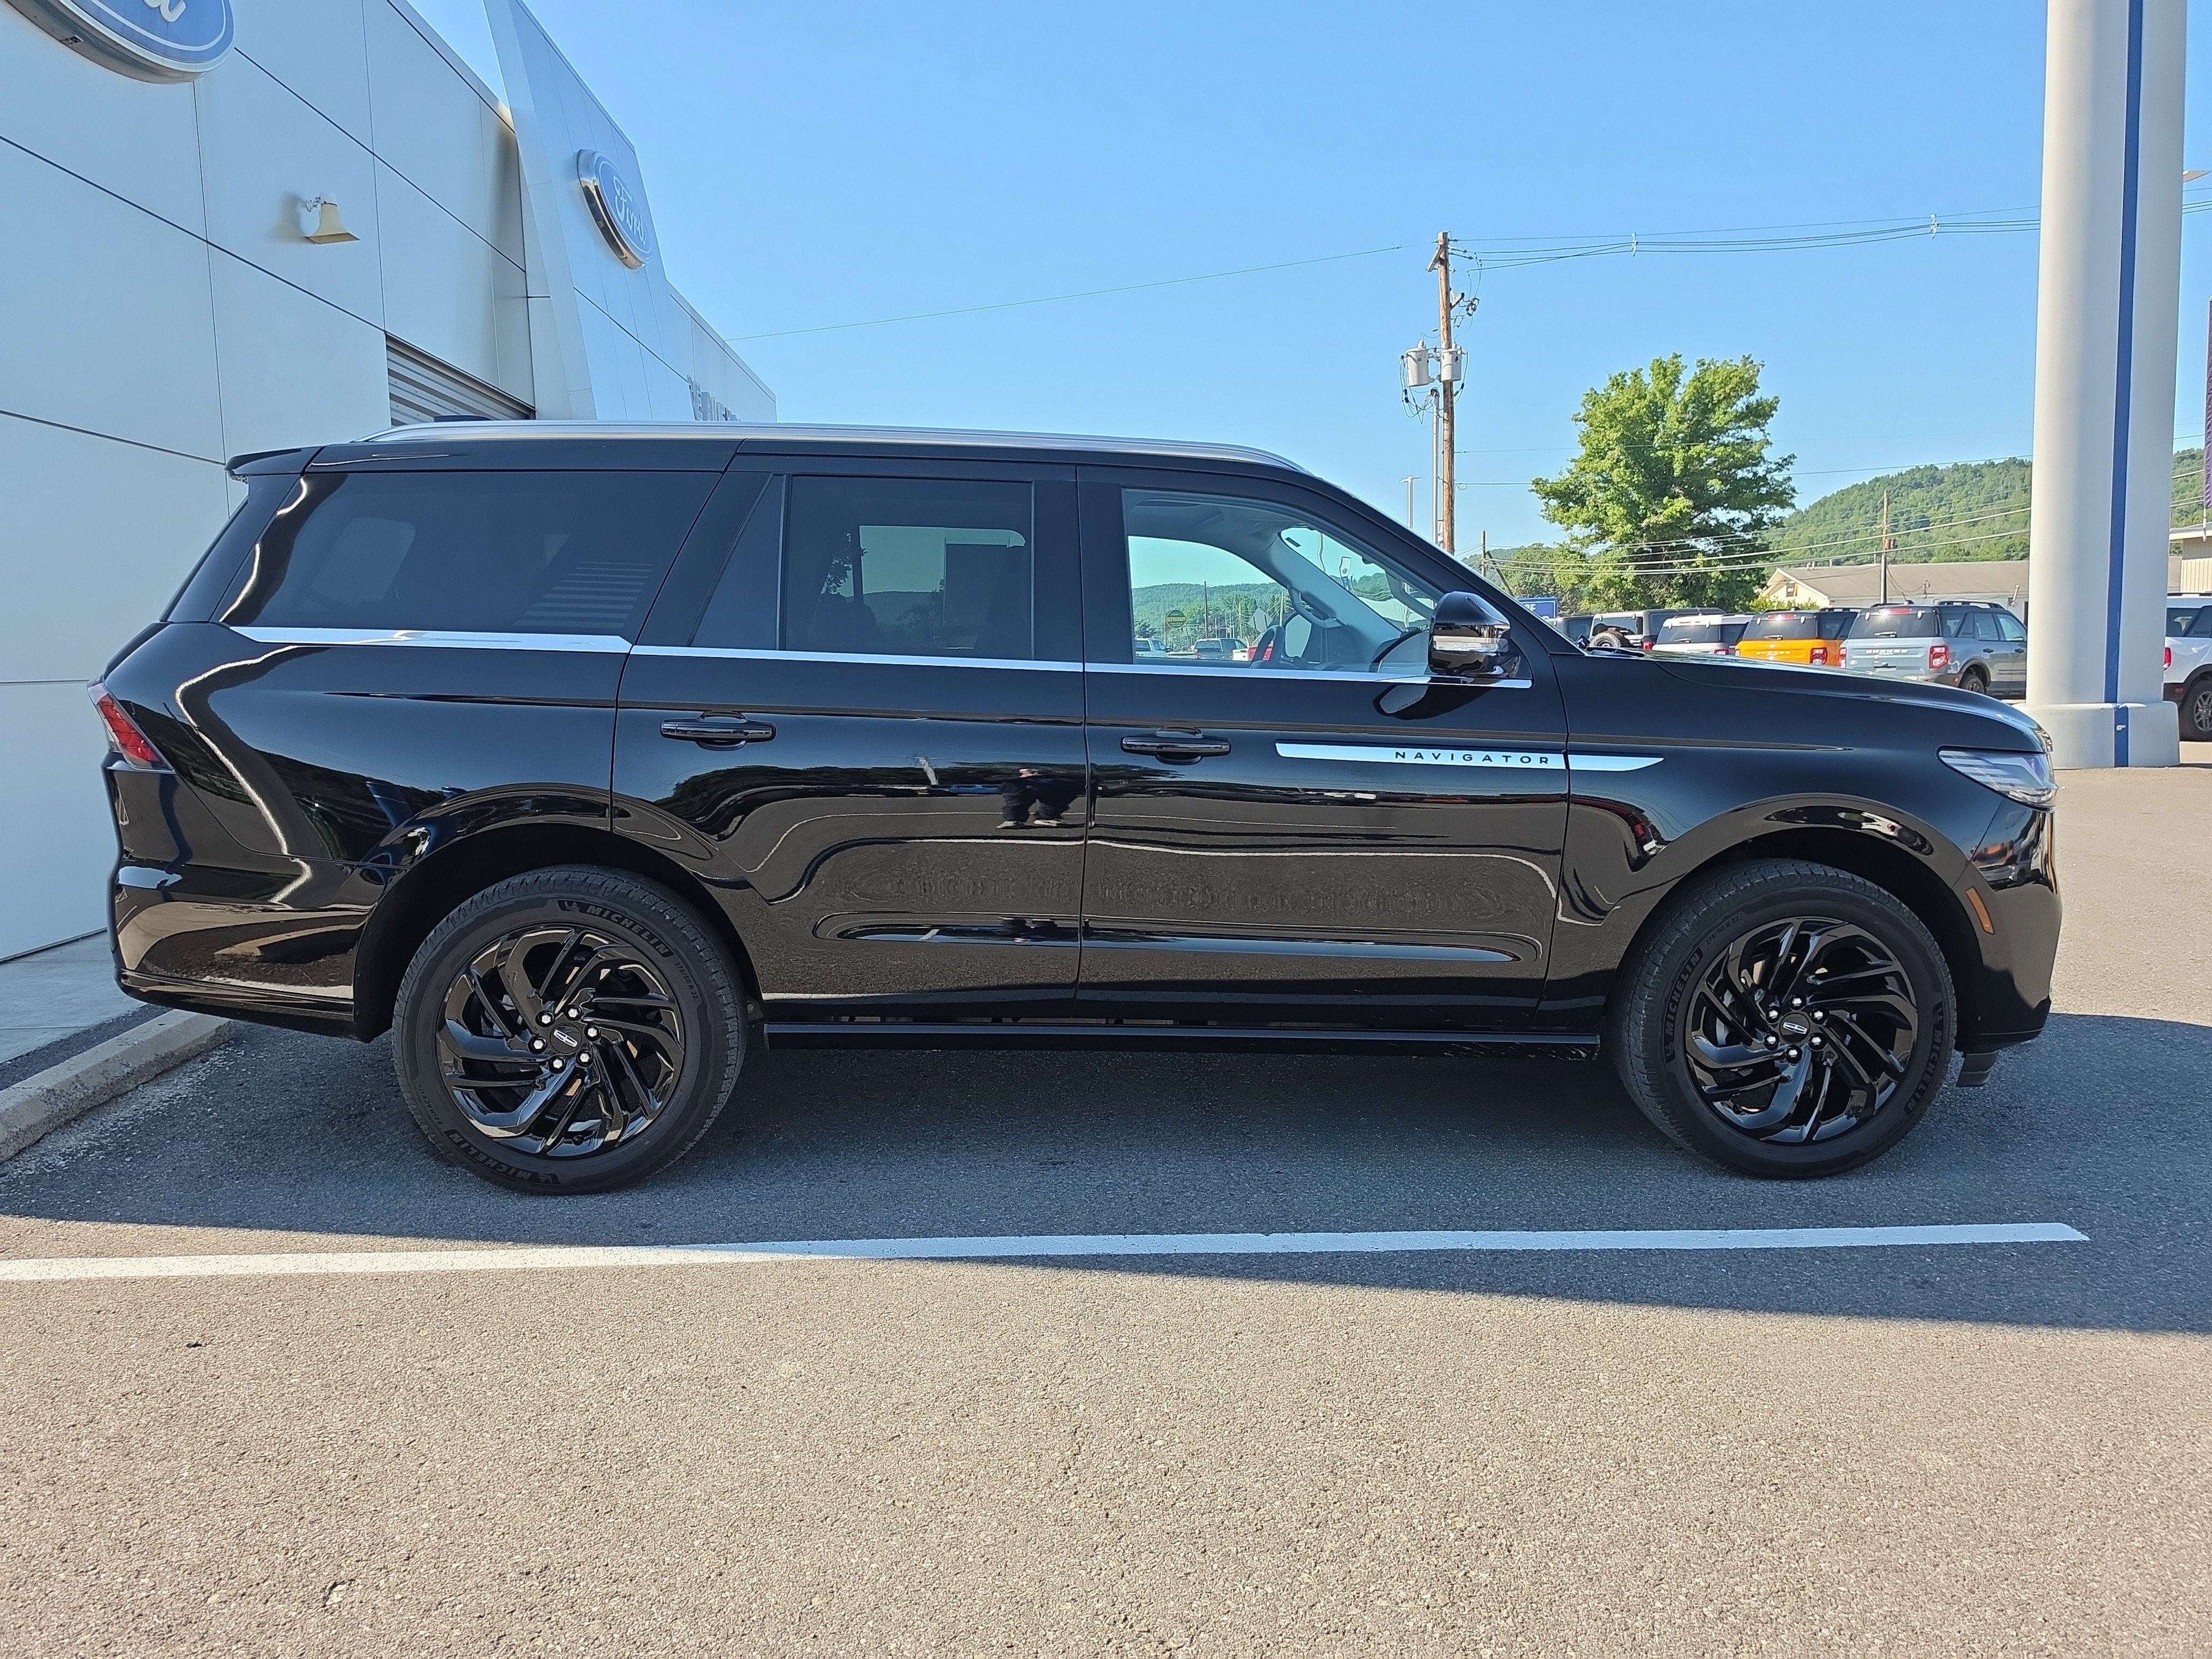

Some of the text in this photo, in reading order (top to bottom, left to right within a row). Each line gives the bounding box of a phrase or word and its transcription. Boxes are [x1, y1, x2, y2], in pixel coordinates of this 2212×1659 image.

[613, 176, 646, 246] Ford
[1395, 751, 1548, 764] NAVIGATOR
[586, 905, 669, 954] MICHELIN
[1706, 926, 1724, 946] 275/50
[674, 962, 691, 983] 275/50
[1666, 953, 1700, 1036] MICHELIN
[1906, 1030, 1943, 1111] MICHELIN
[422, 1095, 443, 1125] PRIMACY
[449, 1133, 532, 1180] MICHELIN
